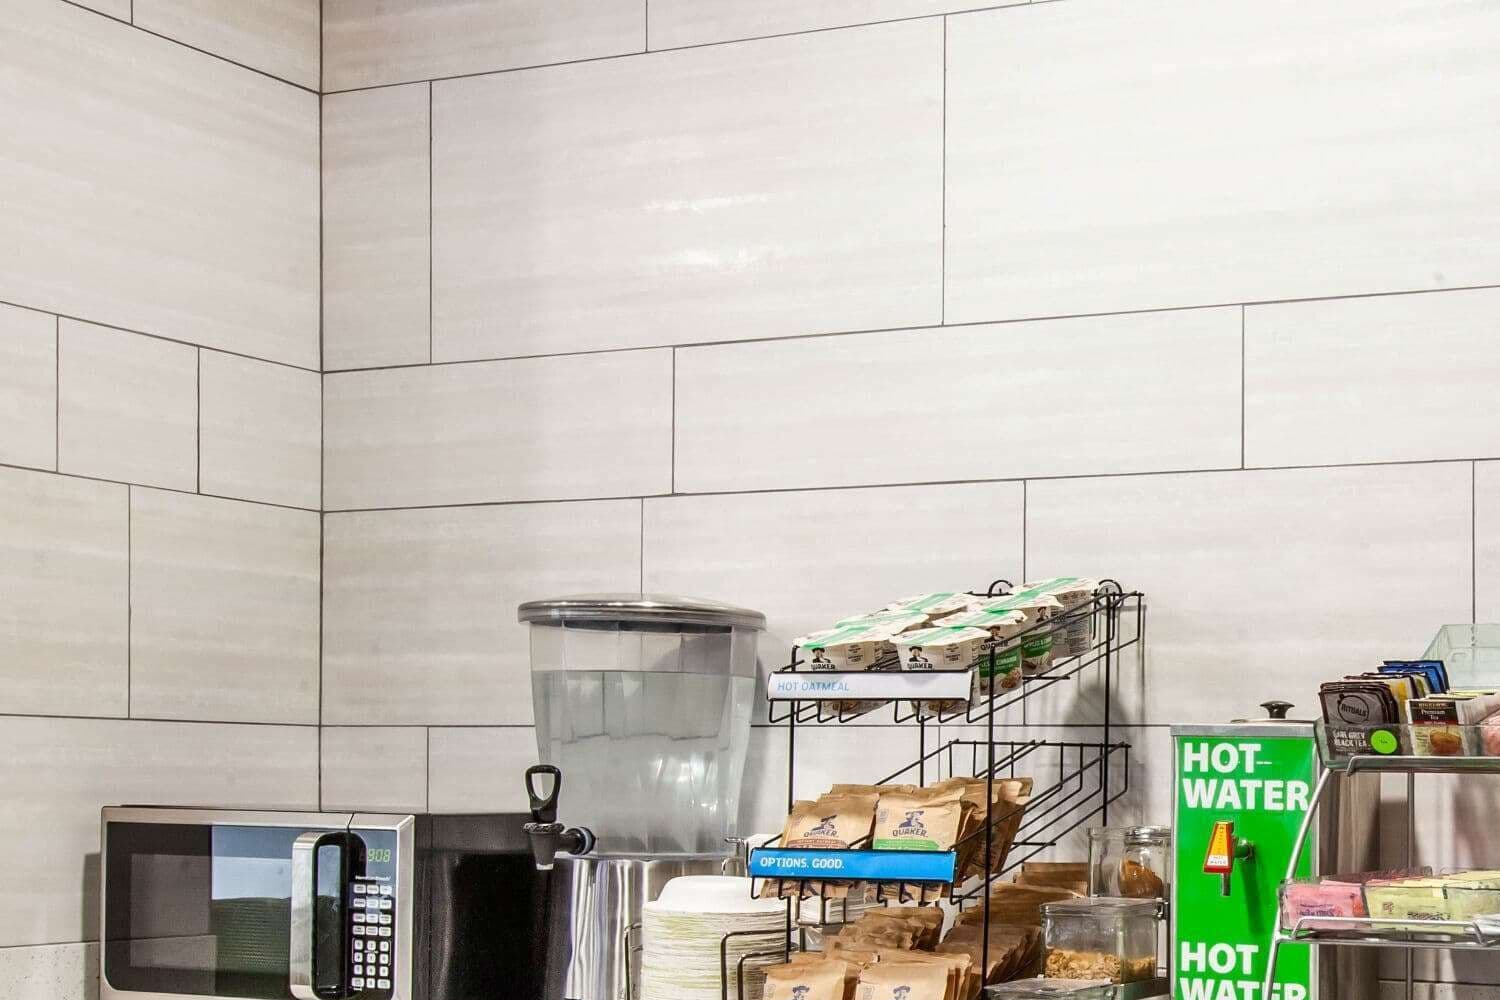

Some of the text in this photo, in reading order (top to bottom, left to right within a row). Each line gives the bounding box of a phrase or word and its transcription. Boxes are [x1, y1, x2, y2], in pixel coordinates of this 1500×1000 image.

[777, 682, 849, 692] HOT OATMEAL
[1183, 742, 1262, 774] HOT
[1182, 778, 1310, 812] WATER
[892, 829, 928, 837] QUAKER
[760, 857, 845, 869] OPTIONS. GOOD.
[1181, 941, 1259, 975] HOT
